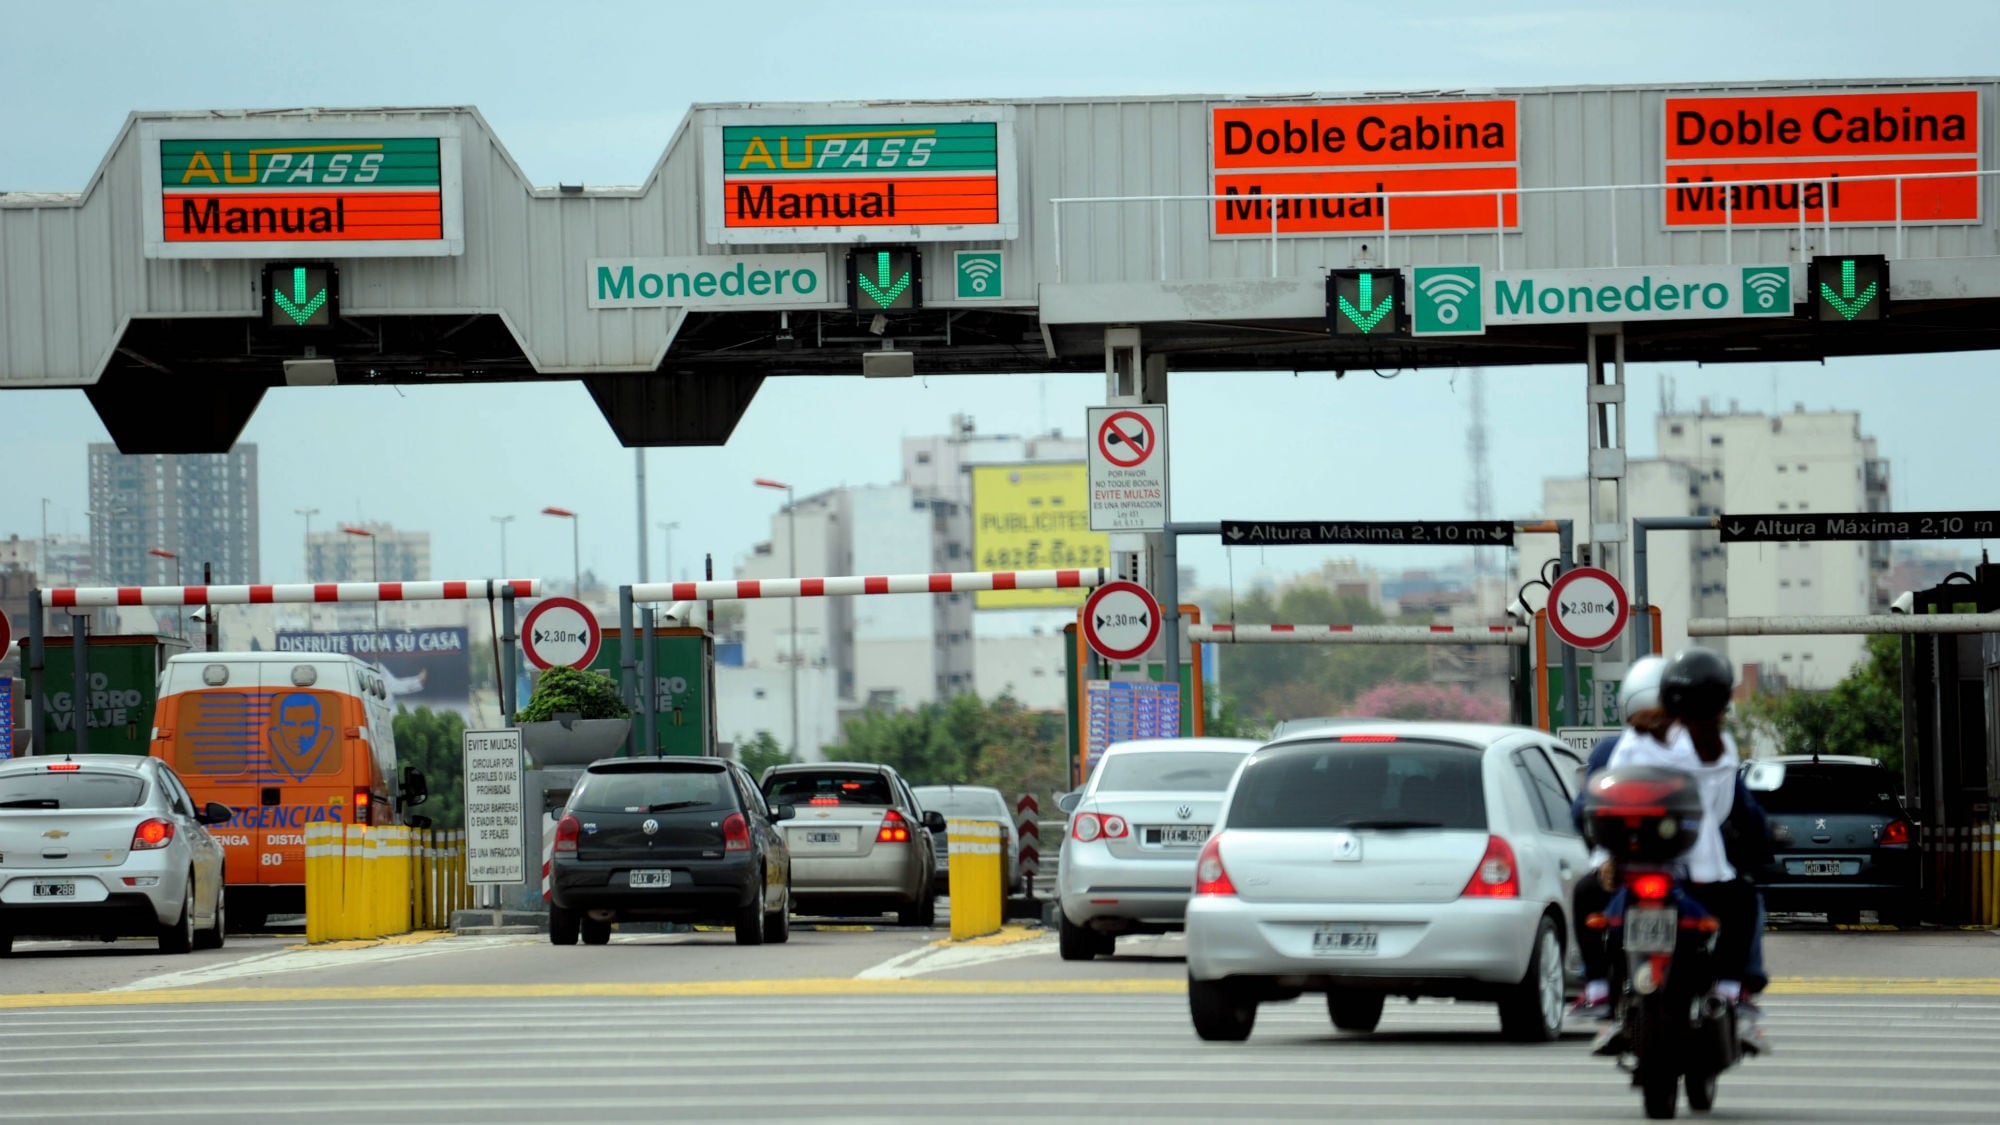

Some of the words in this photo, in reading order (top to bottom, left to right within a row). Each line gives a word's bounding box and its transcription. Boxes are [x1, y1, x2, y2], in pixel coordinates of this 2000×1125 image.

[1676, 110, 1801, 146] Doble
[1812, 106, 1965, 144] Cabina
[1224, 119, 1346, 155] Doble
[1356, 115, 1504, 152] Cabina
[1676, 173, 1840, 212] Manual
[737, 184, 896, 219] Manual
[1225, 182, 1384, 220] Manual
[182, 198, 346, 234] Manual
[597, 262, 818, 300] Monedero
[1495, 276, 1729, 315] Monedero
[1108, 480, 1131, 488] TOQUE
[1132, 479, 1159, 487] BOCINA
[1095, 489, 1121, 500] EVITE
[1123, 488, 1161, 499] MULTAS
[1094, 502, 1103, 510] ES
[1248, 525, 1312, 540] Altura
[1320, 524, 1404, 540] Máxima
[1411, 525, 1459, 541] 2,10
[1466, 528, 1486, 540] m
[1754, 520, 1816, 535] Altura
[1827, 518, 1910, 535] Máxima
[1920, 517, 1963, 536] 2,10
[1974, 520, 1993, 532] m
[1571, 602, 1593, 615] 2,30
[1595, 603, 1604, 613] m
[1106, 614, 1127, 628] 2,30
[1128, 615, 1138, 625] m
[279, 635, 348, 653] DISFRUTE
[418, 631, 461, 650] CASA
[544, 630, 566, 643] 2,30
[567, 632, 576, 642] m
[468, 739, 488, 750] EVITE
[489, 738, 517, 750] MULTAS
[472, 758, 501, 768] CIRCULAR
[501, 757, 514, 768] POR
[470, 772, 497, 782] CARRILES
[503, 771, 517, 781] VIAS
[480, 829, 488, 839] DE
[261, 853, 282, 866] 80
[33, 884, 52, 896] LOK
[56, 884, 75, 896] 288
